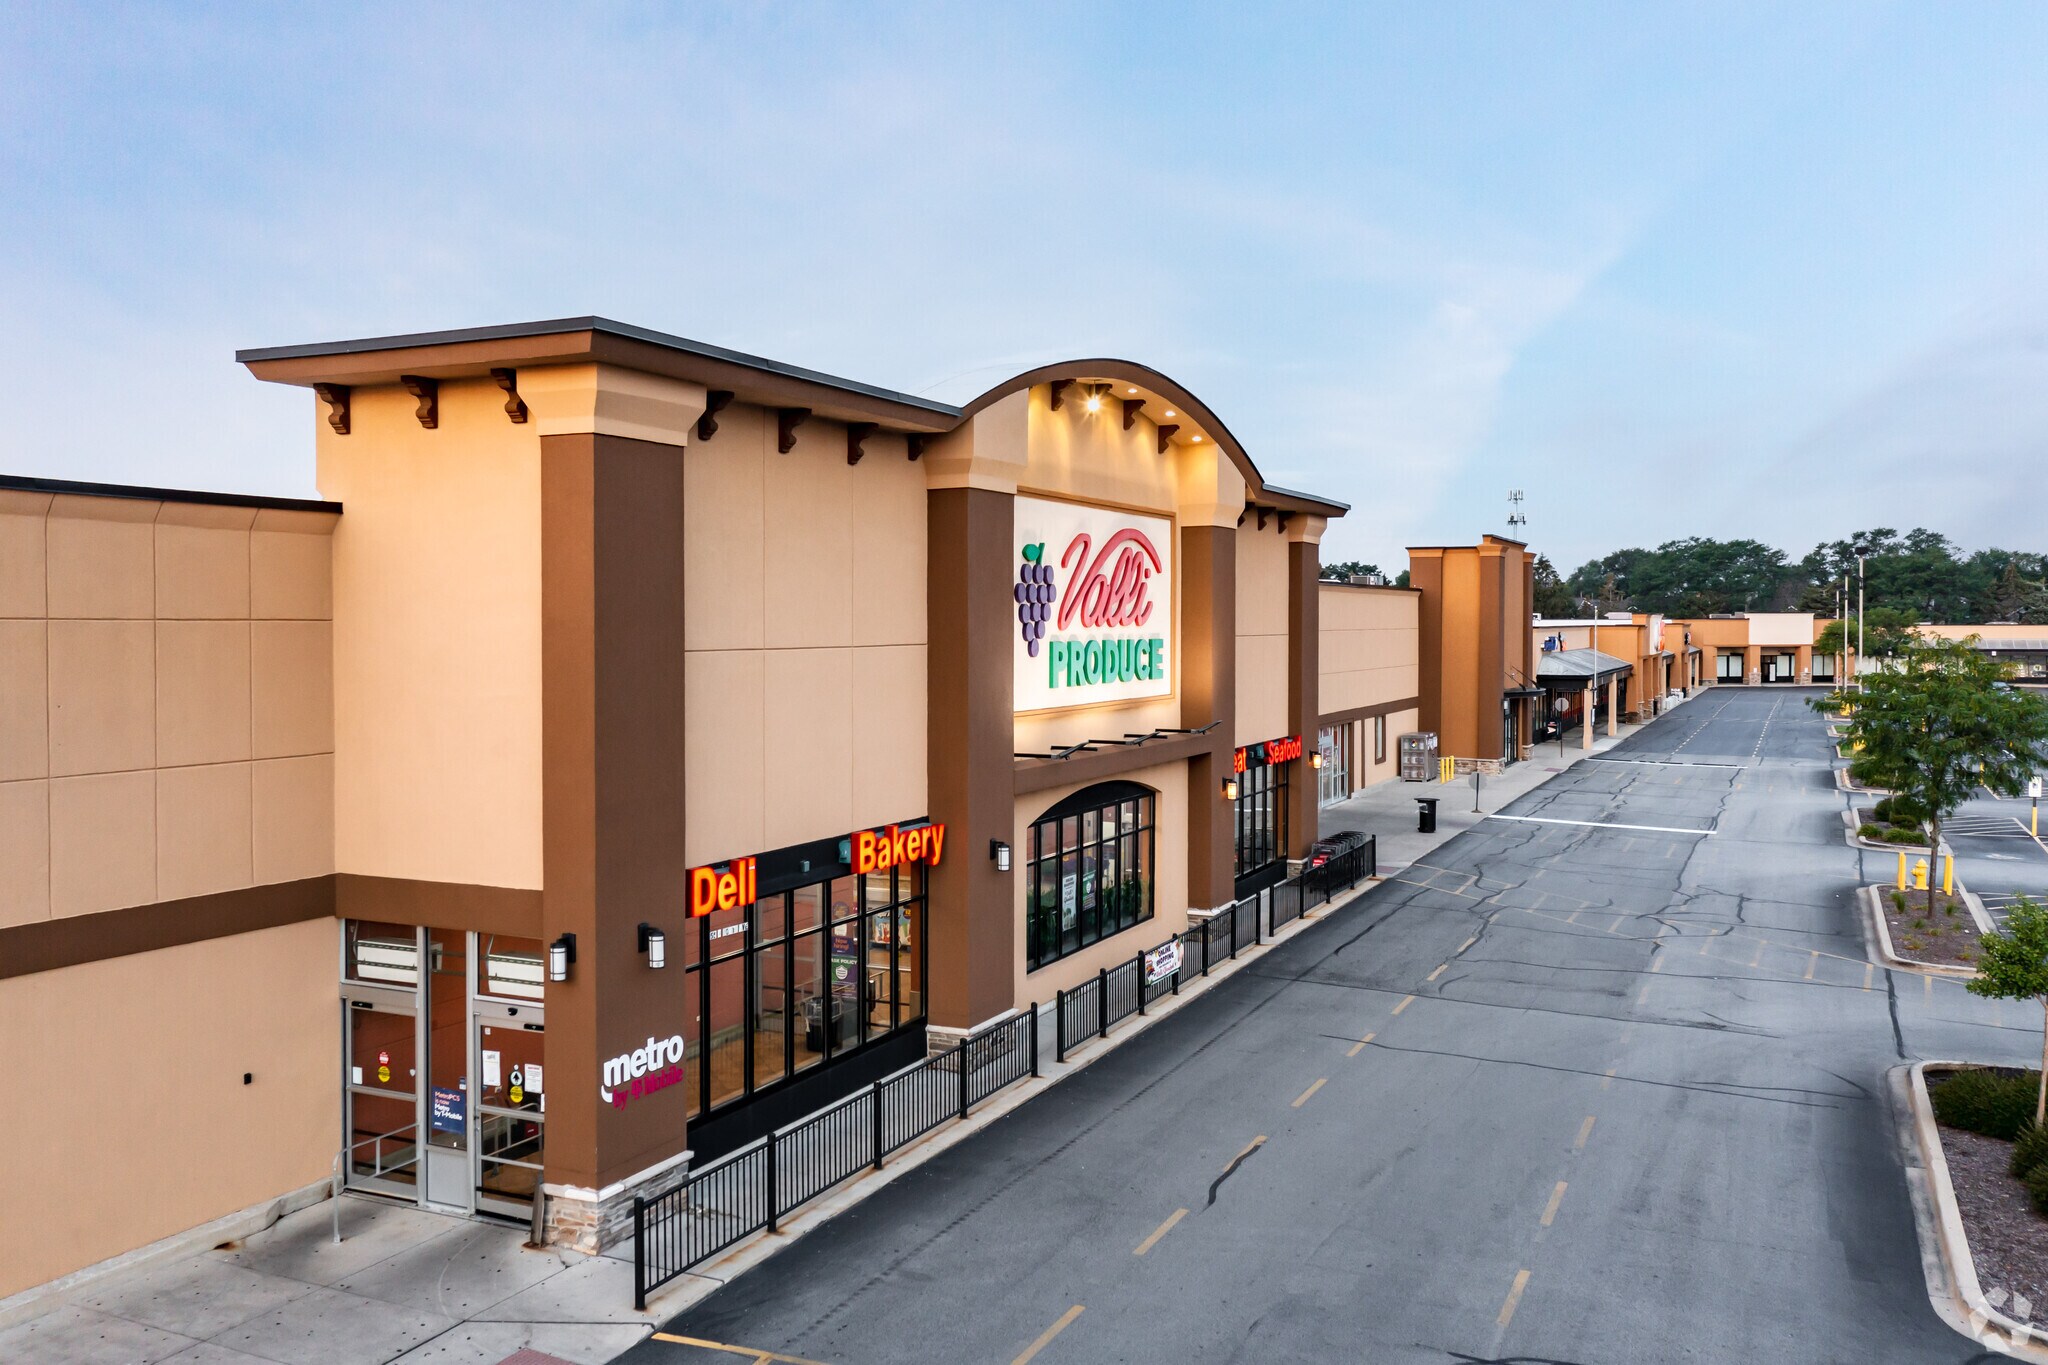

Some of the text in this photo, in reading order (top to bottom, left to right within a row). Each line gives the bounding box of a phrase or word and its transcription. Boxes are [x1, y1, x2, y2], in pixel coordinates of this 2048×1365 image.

[1057, 528, 1162, 631] Valli
[1049, 638, 1164, 689] PRODUCE
[1234, 747, 1248, 773] eat
[1266, 736, 1302, 766] Seafood
[855, 824, 944, 874] Bakery
[689, 856, 757, 918] Deli
[601, 1034, 684, 1103] metro
[613, 1088, 628, 1111] by
[645, 1065, 684, 1096] Mobile
